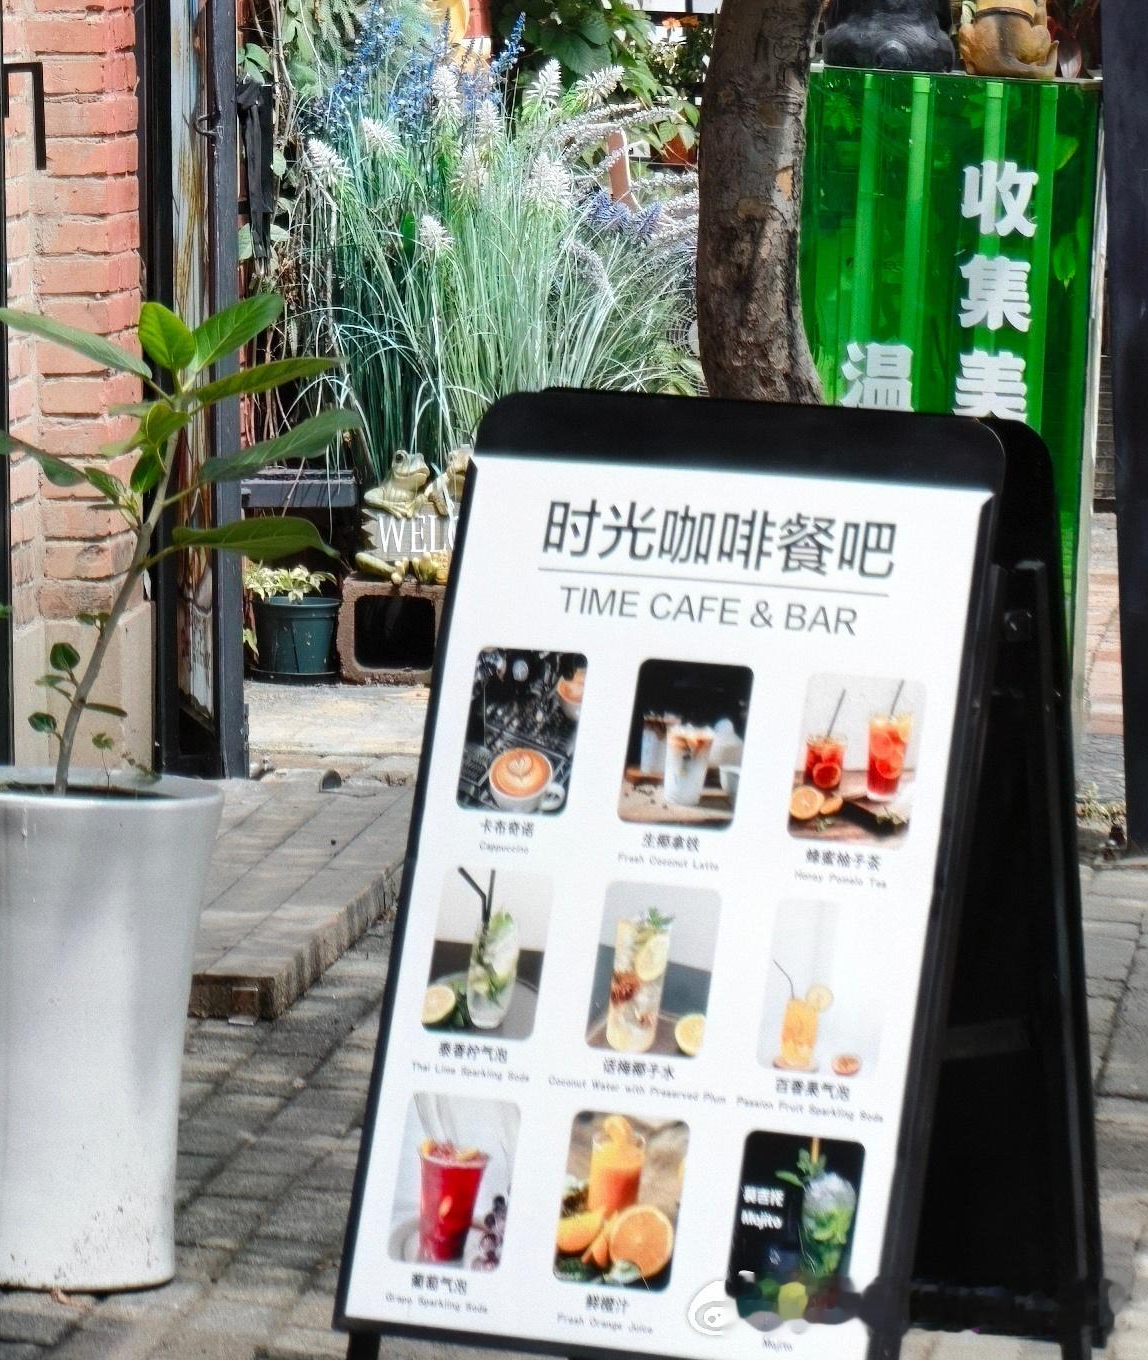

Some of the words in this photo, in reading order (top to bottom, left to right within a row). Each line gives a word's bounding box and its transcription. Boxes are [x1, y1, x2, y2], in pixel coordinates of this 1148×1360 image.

[839, 342, 915, 413] 温
[542, 499, 897, 580] 时光咖啡餐吧
[559, 585, 640, 618] TIME
[649, 591, 741, 626] CAFE
[749, 600, 774, 629] &
[784, 603, 858, 636] BAR
